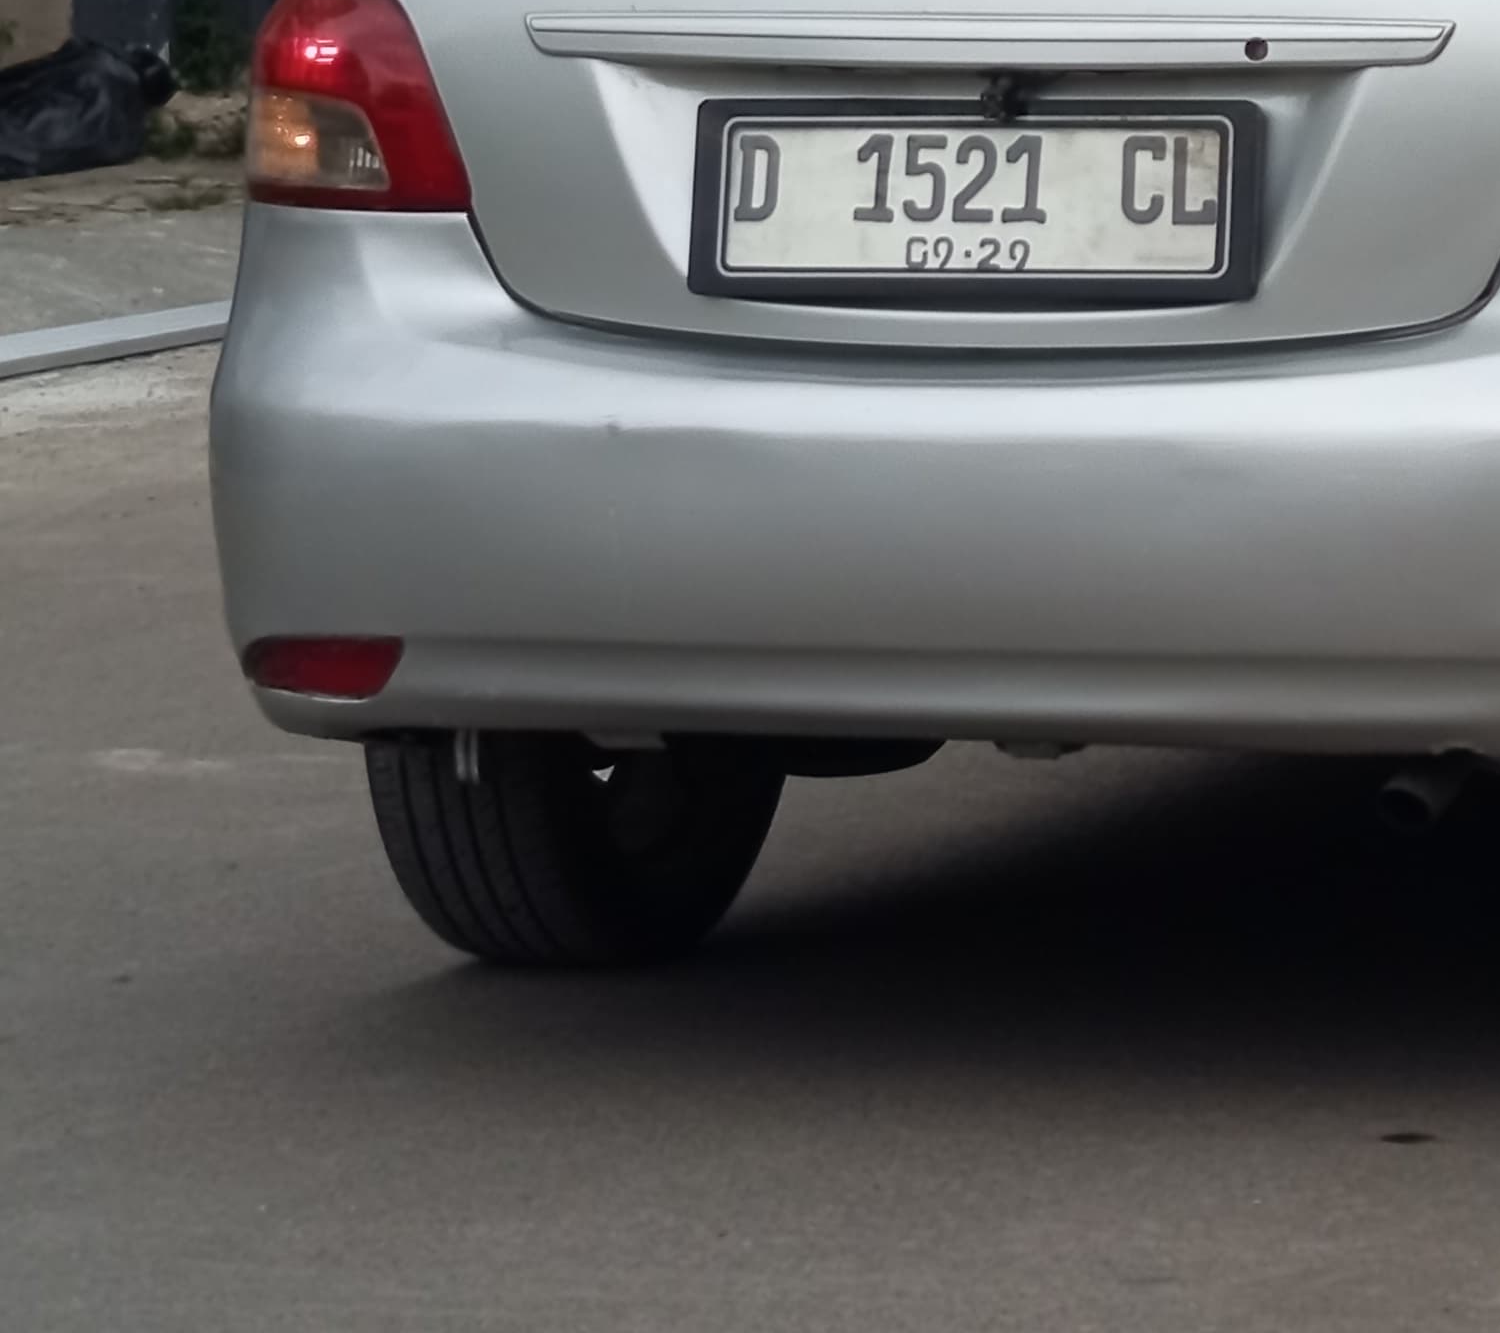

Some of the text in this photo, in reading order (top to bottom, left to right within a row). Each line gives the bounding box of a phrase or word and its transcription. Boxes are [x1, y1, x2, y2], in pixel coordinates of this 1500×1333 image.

[733, 133, 1218, 226] D 1521 CL
